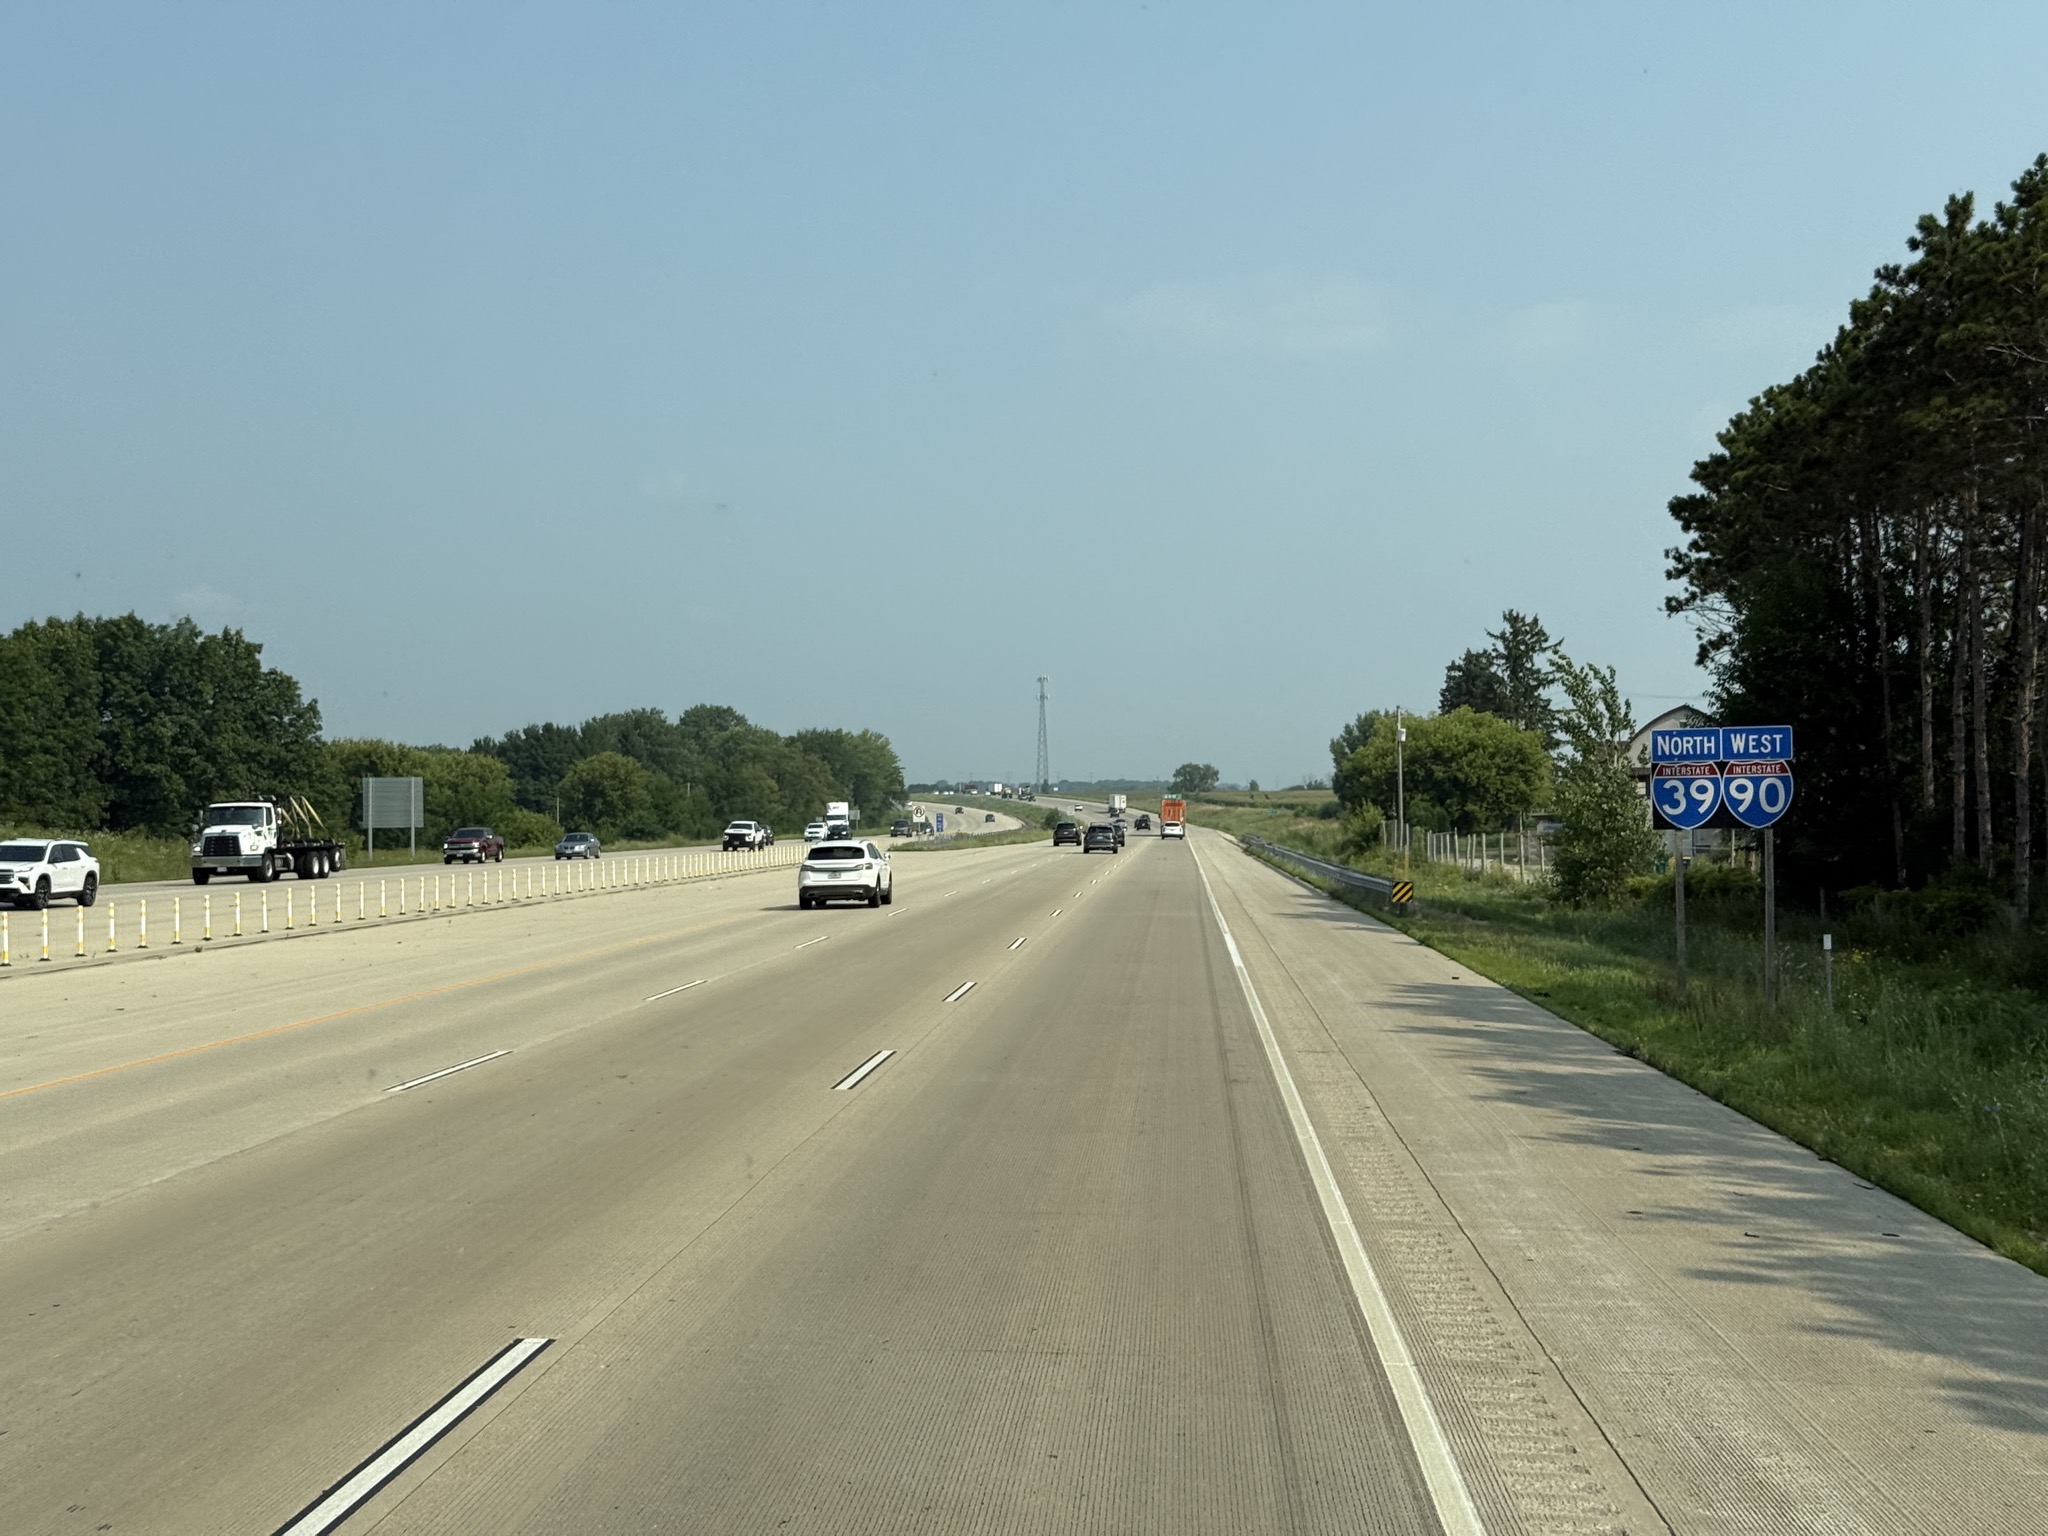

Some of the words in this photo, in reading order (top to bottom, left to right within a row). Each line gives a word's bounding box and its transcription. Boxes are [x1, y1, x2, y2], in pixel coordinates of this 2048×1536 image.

[1657, 736, 1715, 756] NORTH
[1730, 733, 1783, 754] WEST
[1662, 765, 1710, 776] INTERSTATE
[1732, 764, 1782, 774] INTERSTATE
[1662, 779, 1715, 815] 39
[1729, 777, 1786, 814] 90
